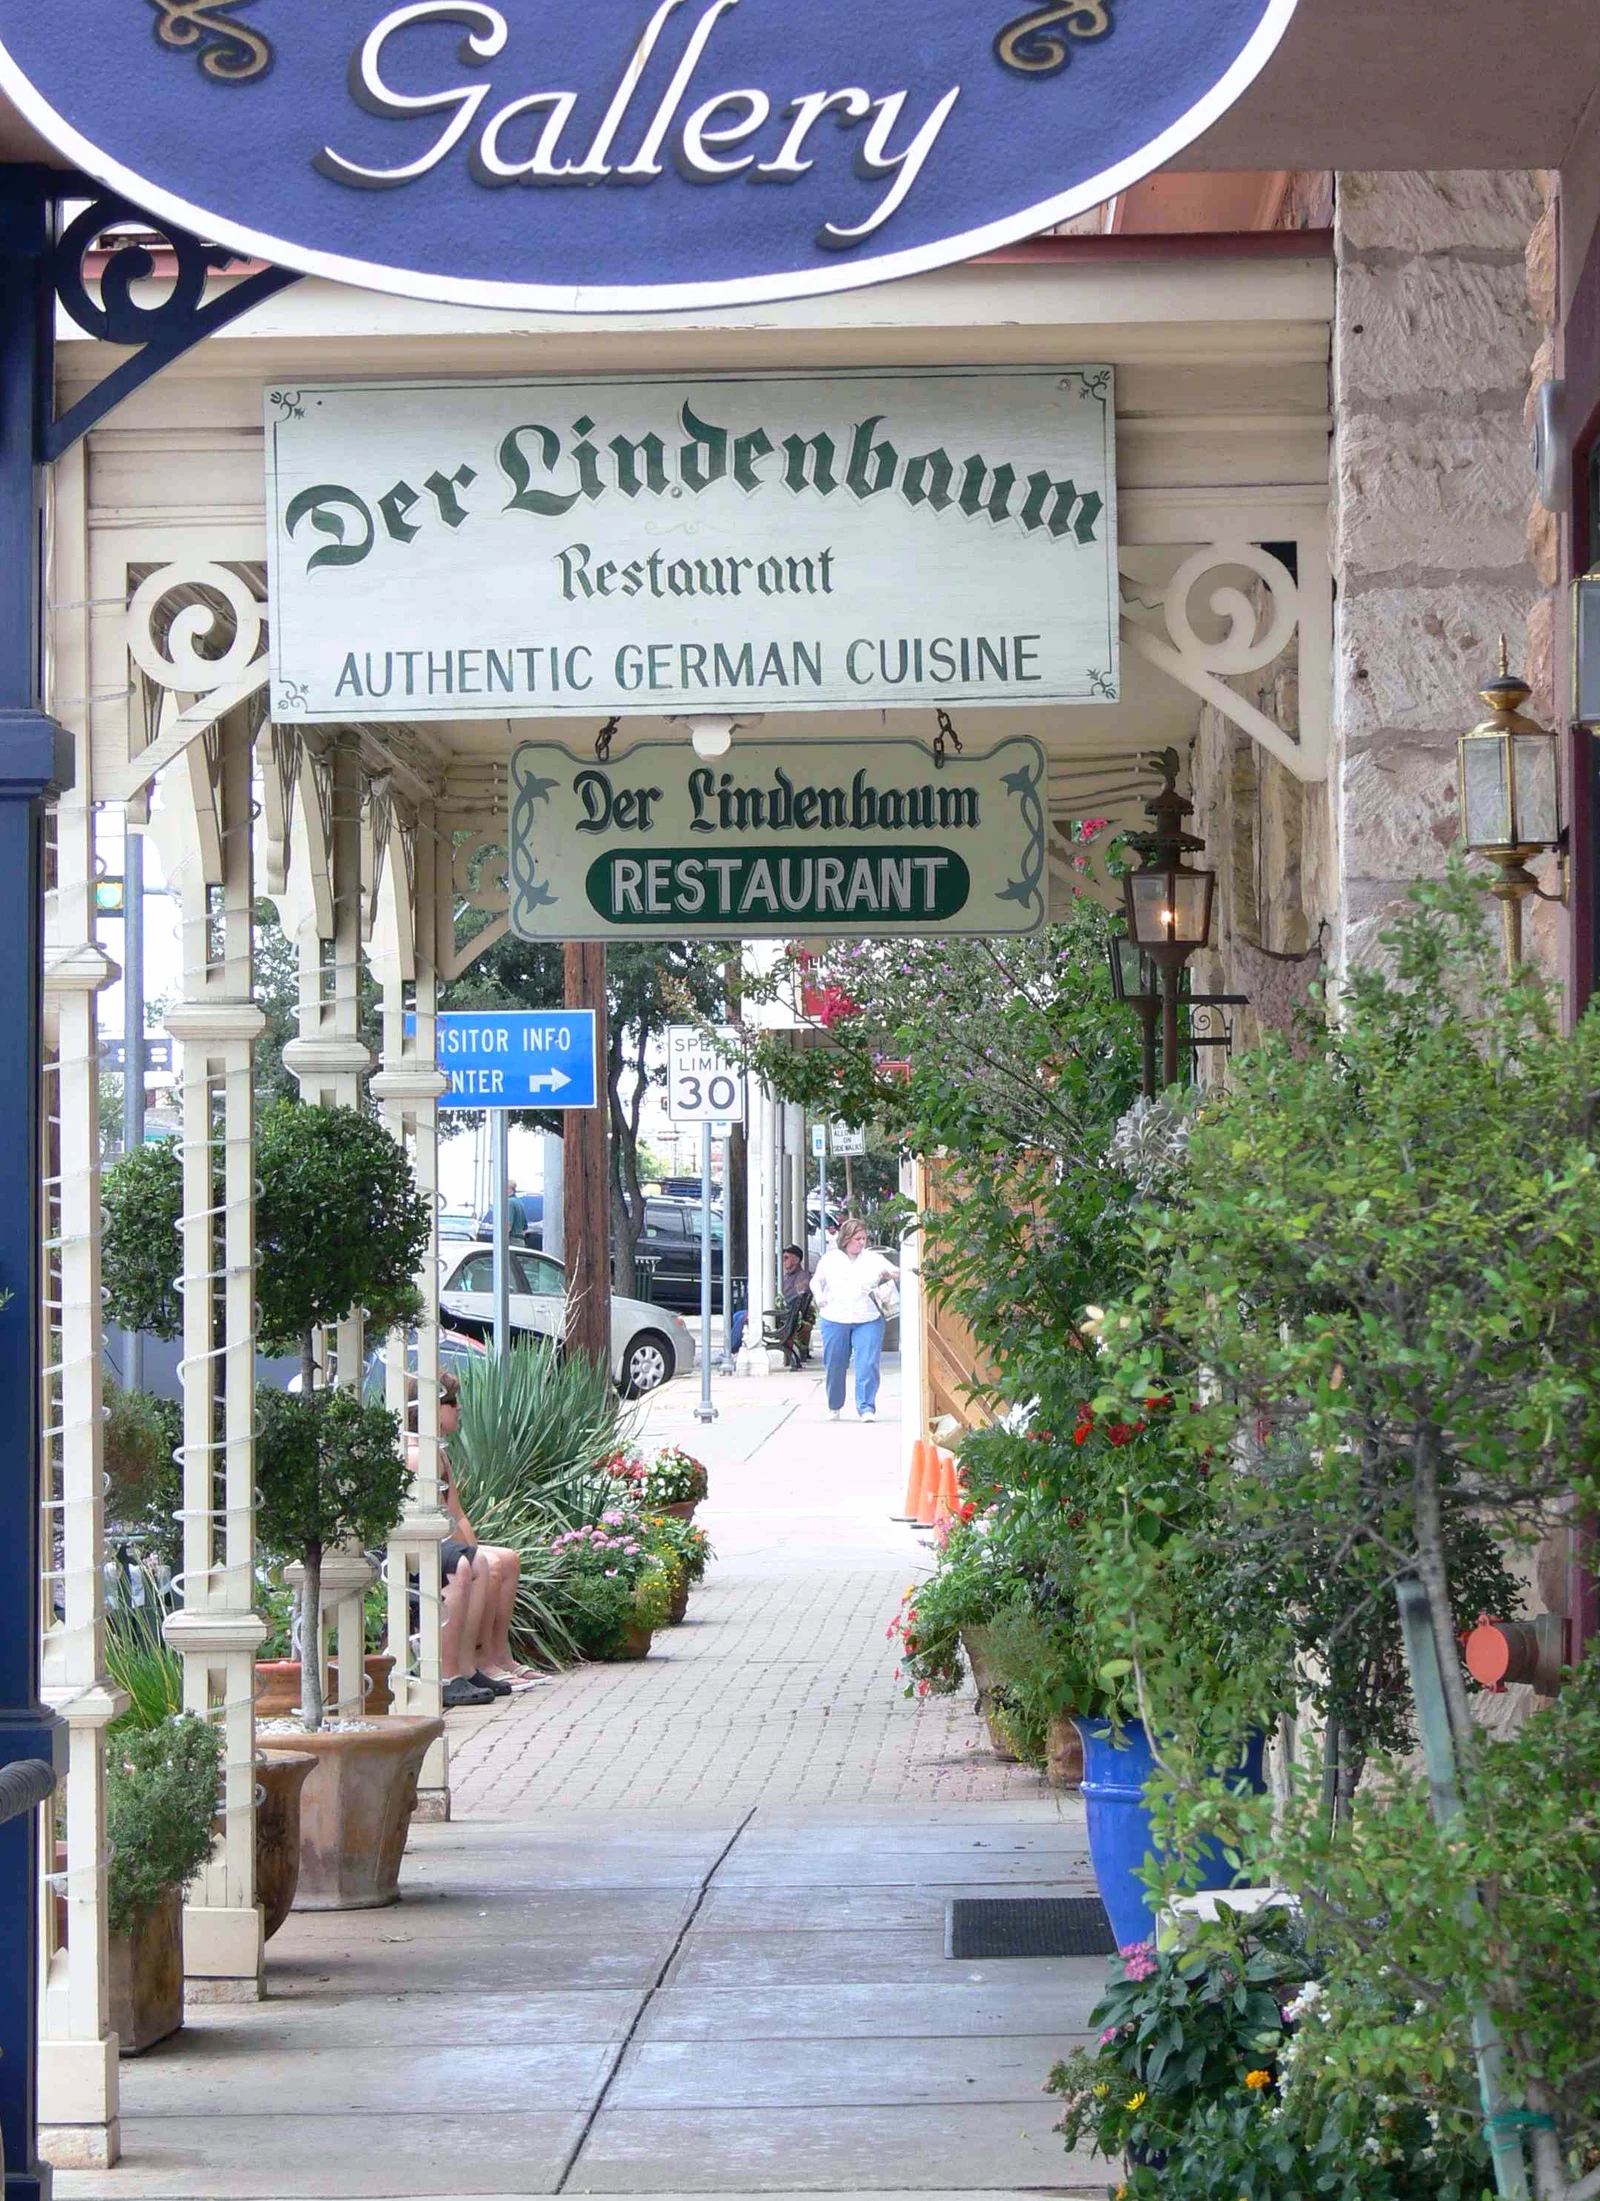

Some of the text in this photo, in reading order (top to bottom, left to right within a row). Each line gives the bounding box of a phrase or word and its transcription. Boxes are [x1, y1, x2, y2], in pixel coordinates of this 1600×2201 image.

[320, 0, 961, 242] Gallery
[285, 396, 1105, 570] Der Lindenbaum
[553, 544, 836, 601] Restaurant
[335, 634, 1042, 697] AUTHENTIC GERMAN CUISINE
[573, 767, 982, 834] Der Lindenbaum
[610, 857, 949, 914] RESTAURANT
[438, 1027, 571, 1053] ISITOR INFO
[674, 1037, 737, 1052] SPE
[439, 1069, 504, 1094] NTER
[677, 1076, 736, 1110] 30
[833, 1128, 861, 1137] ALLOD
